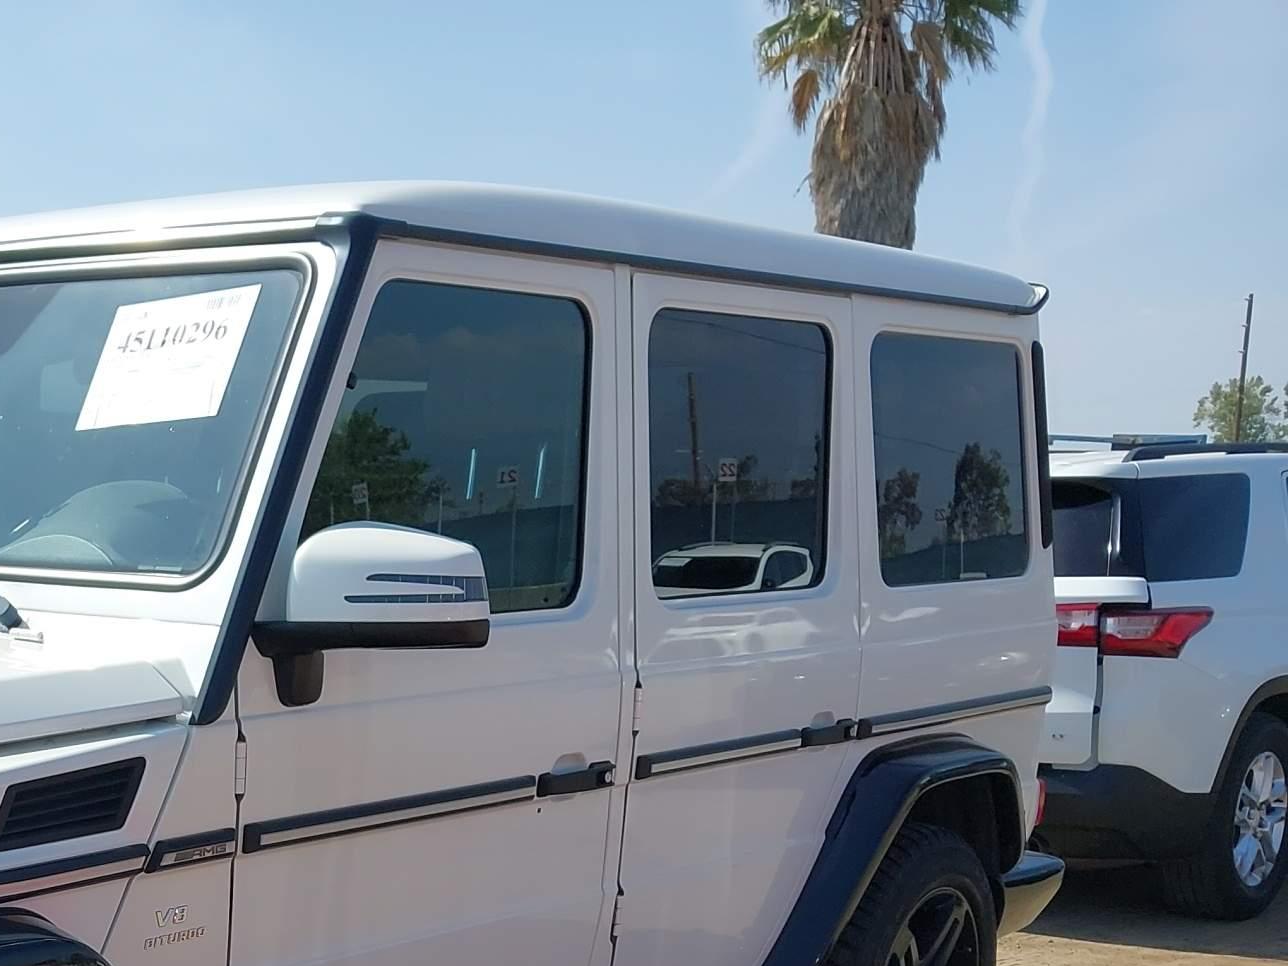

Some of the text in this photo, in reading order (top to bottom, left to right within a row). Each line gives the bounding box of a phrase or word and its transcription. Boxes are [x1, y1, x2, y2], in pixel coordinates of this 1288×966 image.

[117, 318, 230, 354] 45110296
[155, 904, 189, 928] V8
[143, 926, 207, 950] BITURBO
